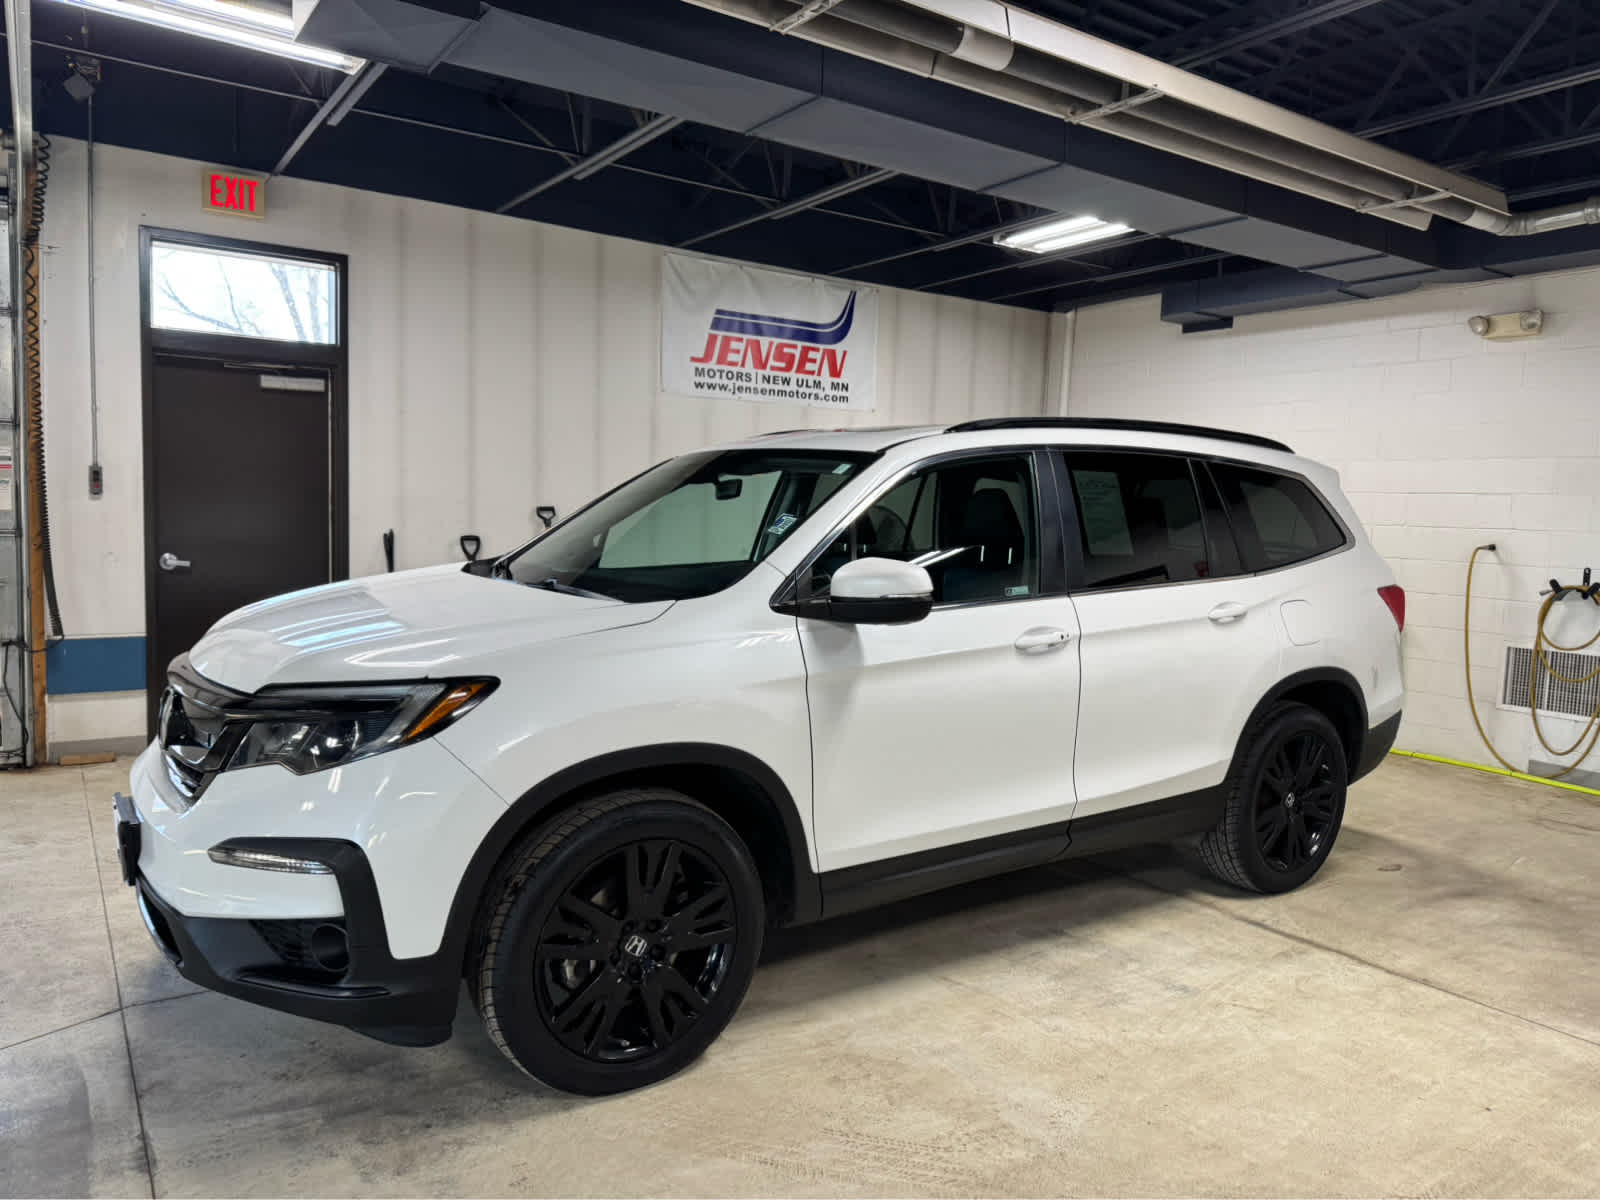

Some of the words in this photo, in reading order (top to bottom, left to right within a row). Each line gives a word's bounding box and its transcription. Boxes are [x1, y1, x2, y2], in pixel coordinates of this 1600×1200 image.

[210, 174, 259, 212] EXIT
[689, 333, 848, 379] JENSEN
[693, 380, 849, 403] www.jensenmotors.com
[694, 367, 752, 383] MOTORS
[762, 374, 792, 387] NEW
[796, 377, 825, 392] ULM,
[830, 382, 849, 393] MN
